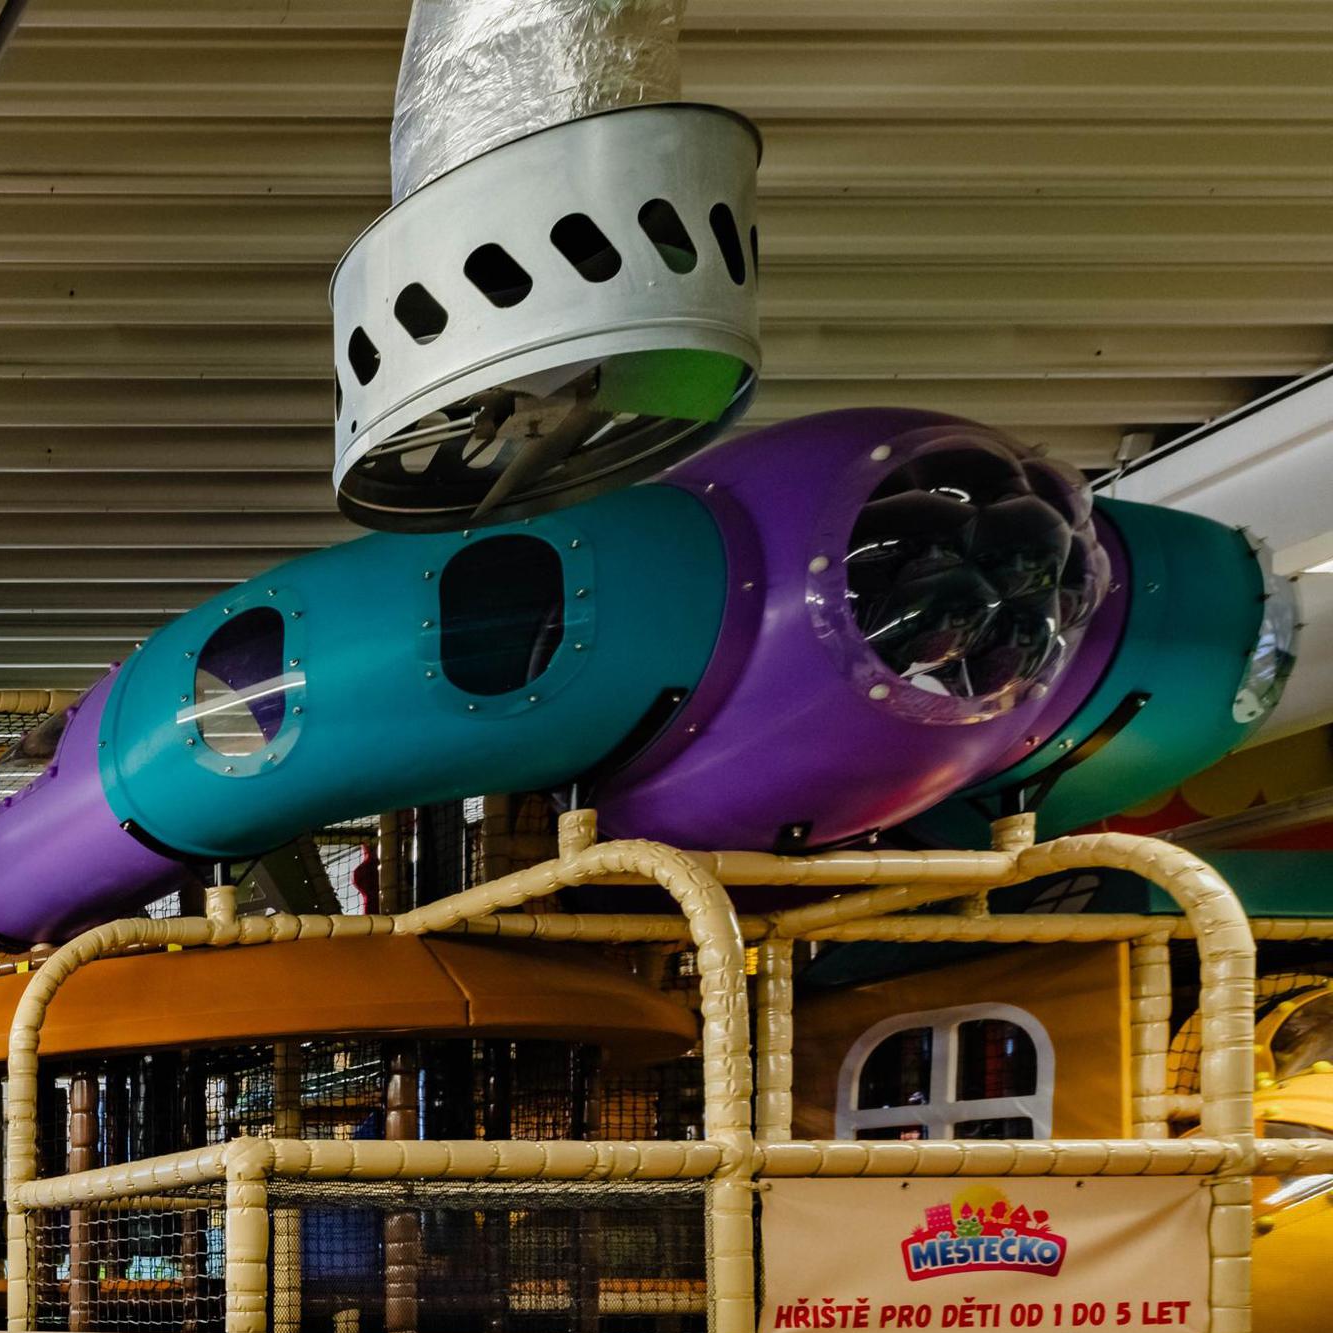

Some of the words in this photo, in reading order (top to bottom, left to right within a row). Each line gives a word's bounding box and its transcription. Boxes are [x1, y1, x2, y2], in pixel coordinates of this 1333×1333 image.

[909, 1229, 1061, 1271] MĚSTEČKO
[774, 1297, 871, 1329] HŘIŠTĚ
[879, 1303, 932, 1328] PRO
[940, 1296, 1001, 1328] DĚTI
[1010, 1303, 1044, 1327] OD
[1052, 1302, 1062, 1326] 1
[1072, 1302, 1106, 1325] DO
[1116, 1301, 1132, 1325] 5
[1142, 1301, 1191, 1324] LET
